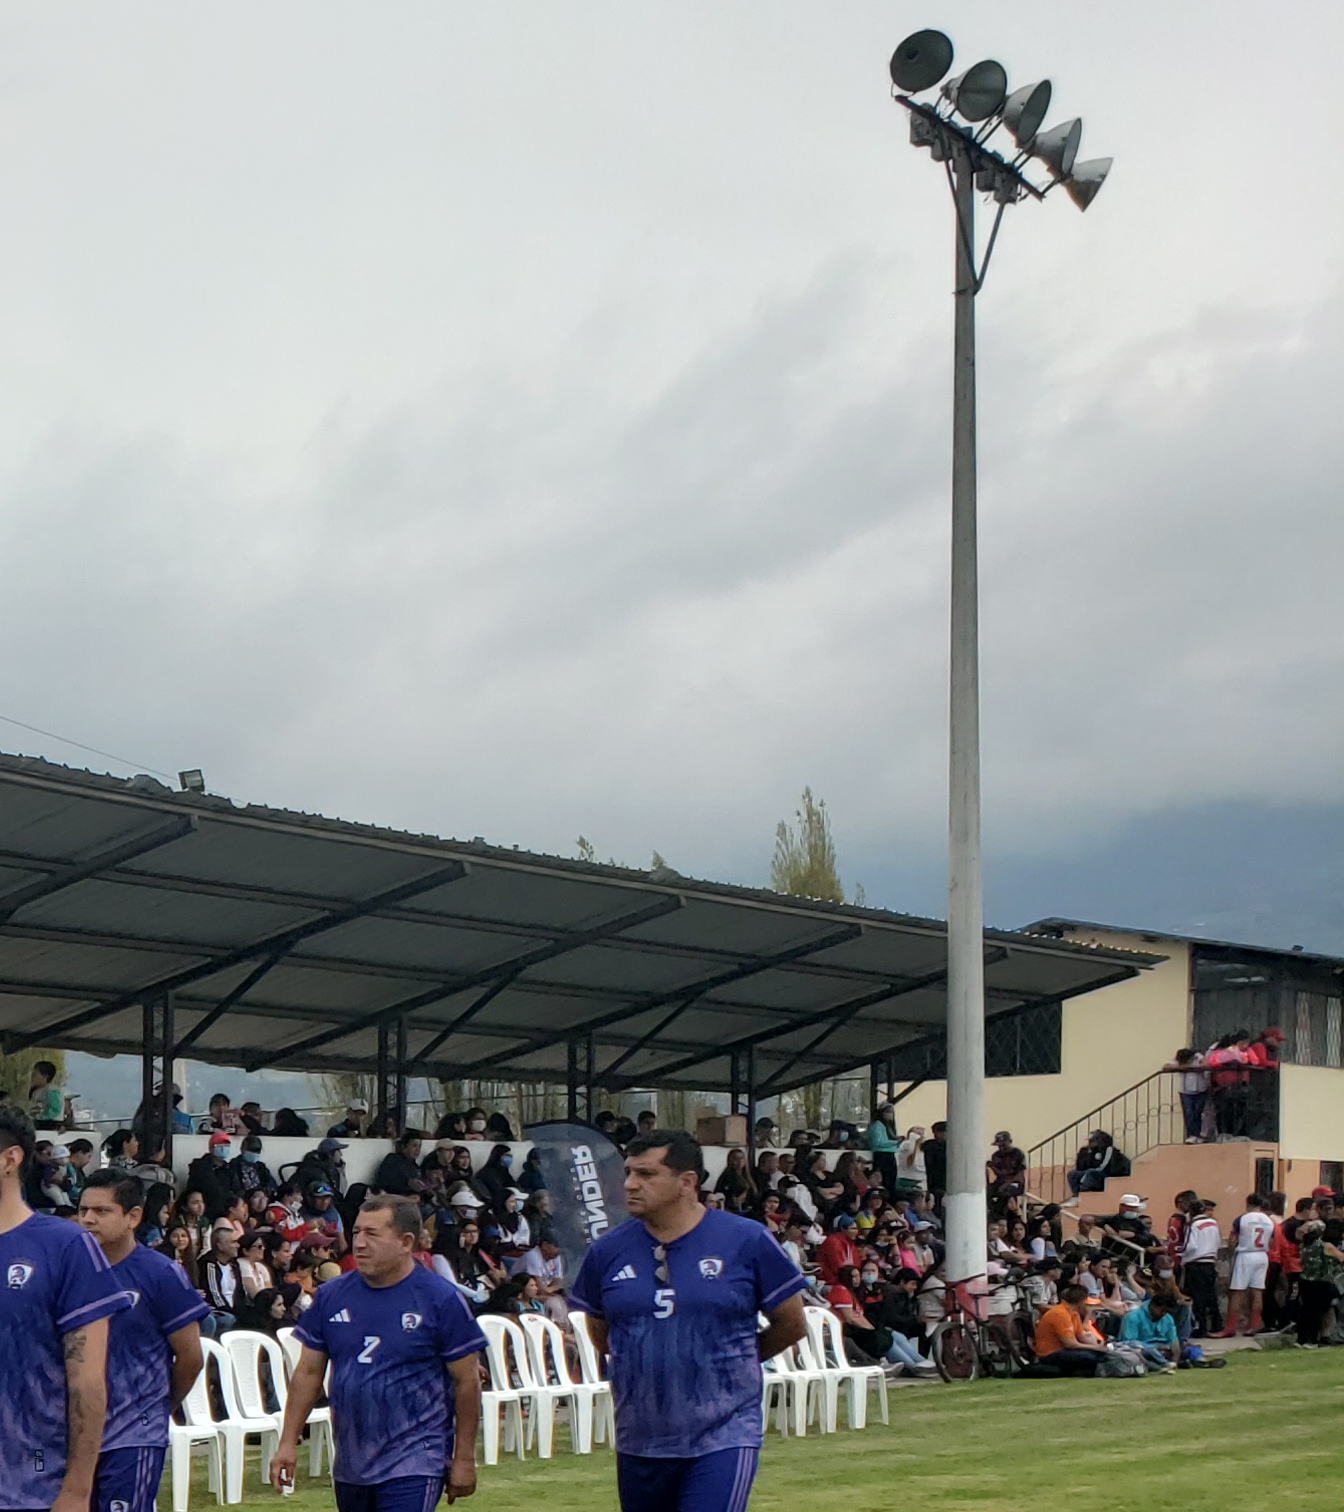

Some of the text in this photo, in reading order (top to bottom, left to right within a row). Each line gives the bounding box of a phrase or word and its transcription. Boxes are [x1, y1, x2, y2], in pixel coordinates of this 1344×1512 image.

[1254, 1227, 1265, 1248] 2
[653, 1288, 676, 1319] 5
[357, 1335, 381, 1364] 2
